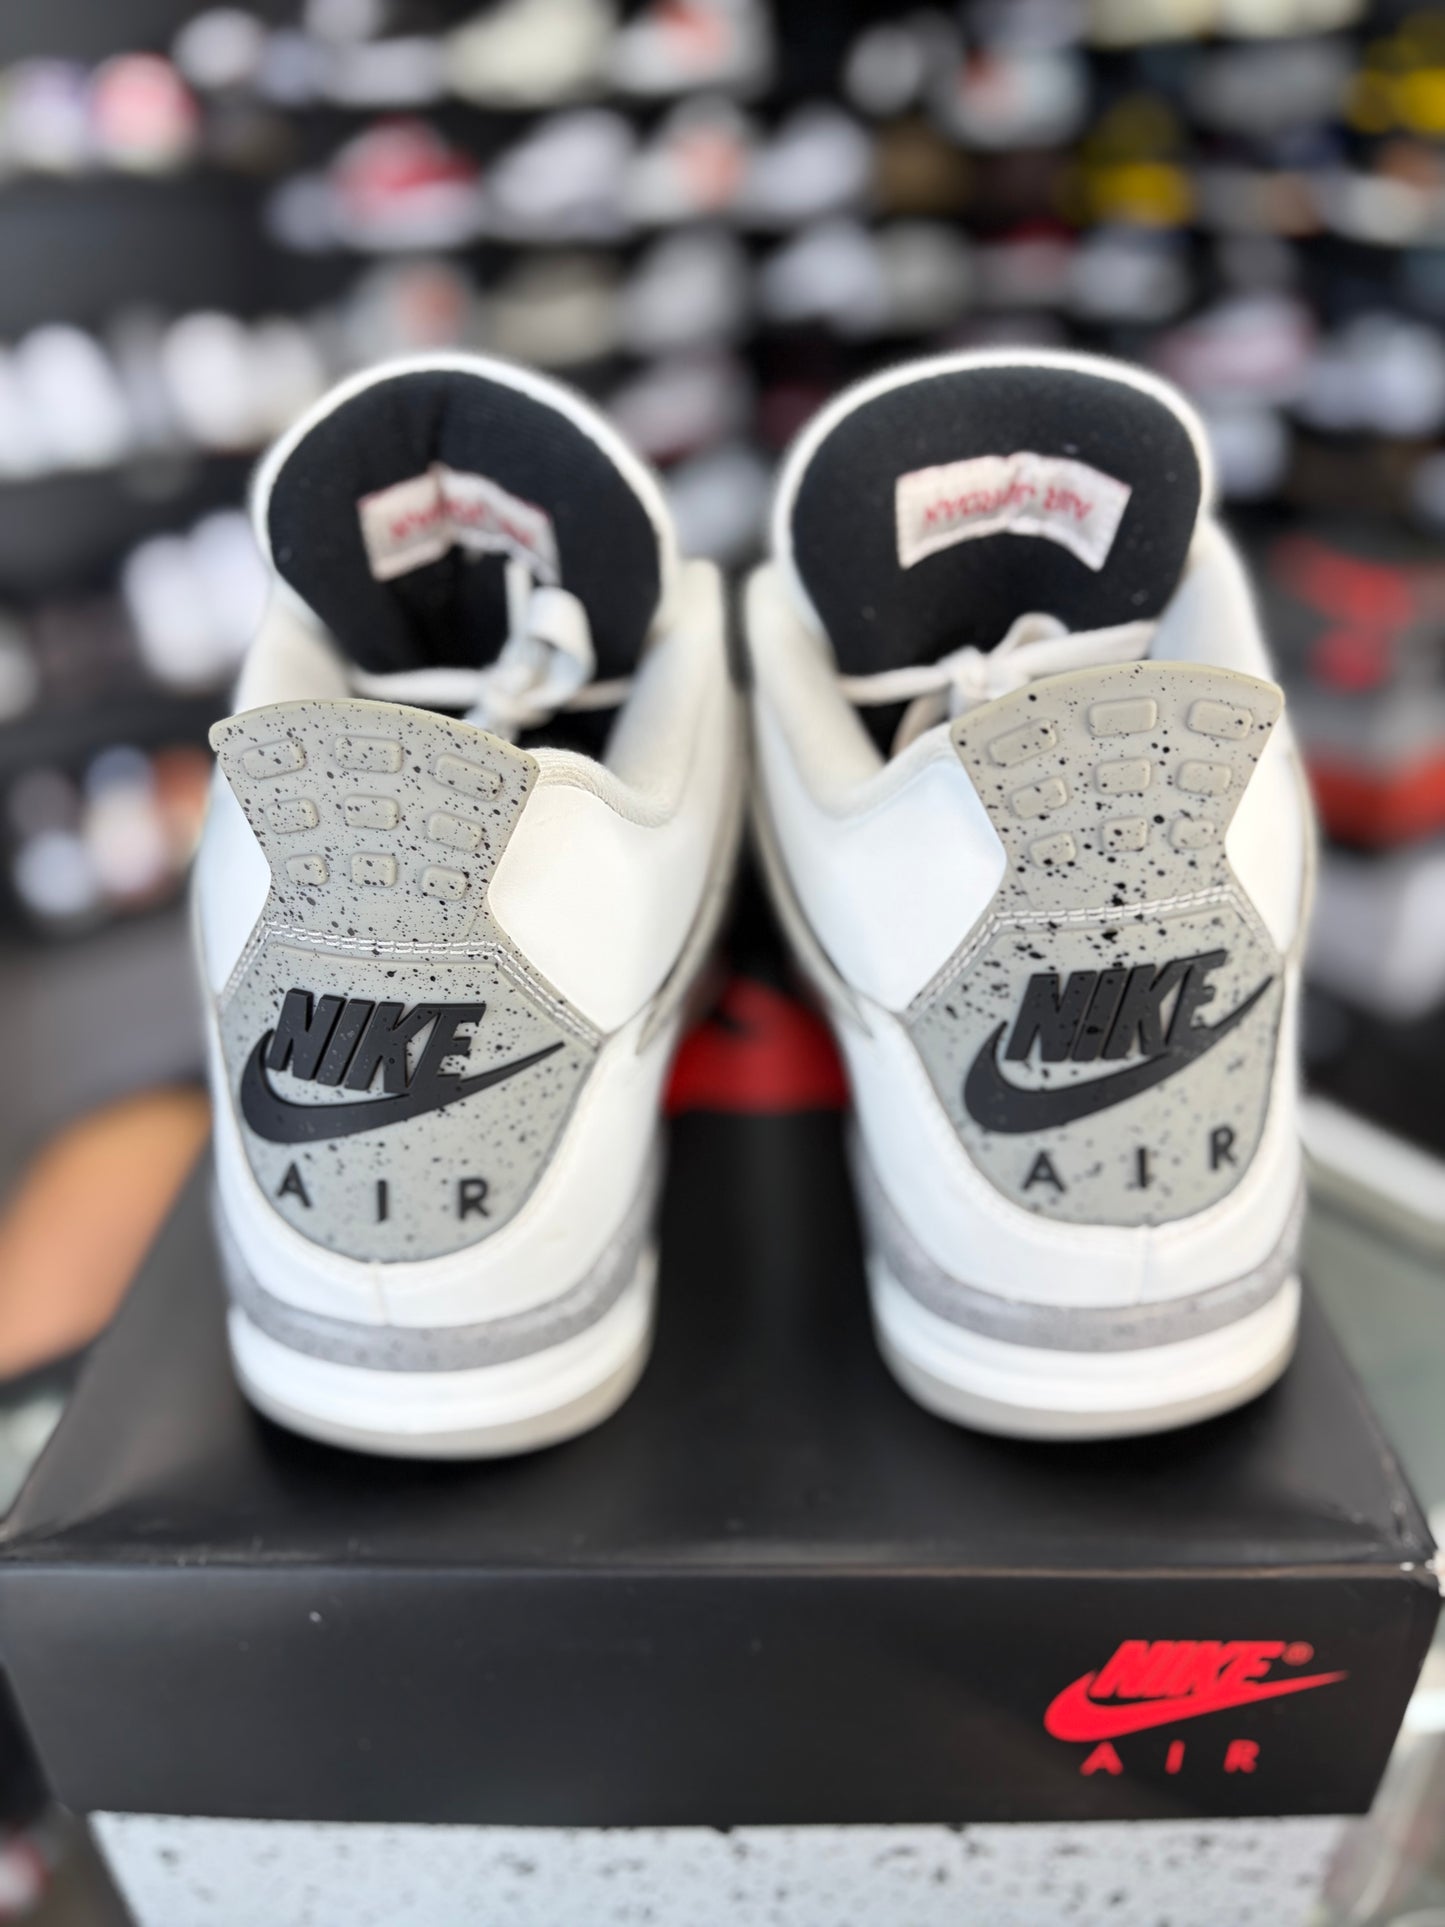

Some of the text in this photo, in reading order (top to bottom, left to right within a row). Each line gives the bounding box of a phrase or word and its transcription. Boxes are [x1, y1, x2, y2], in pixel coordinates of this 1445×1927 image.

[265, 987, 487, 1094] NIKE
[1004, 948, 1229, 1063] NIKE
[276, 1160, 490, 1223] AIR
[1021, 1124, 1238, 1194] AIR
[1079, 1738, 1261, 1777] AIR
